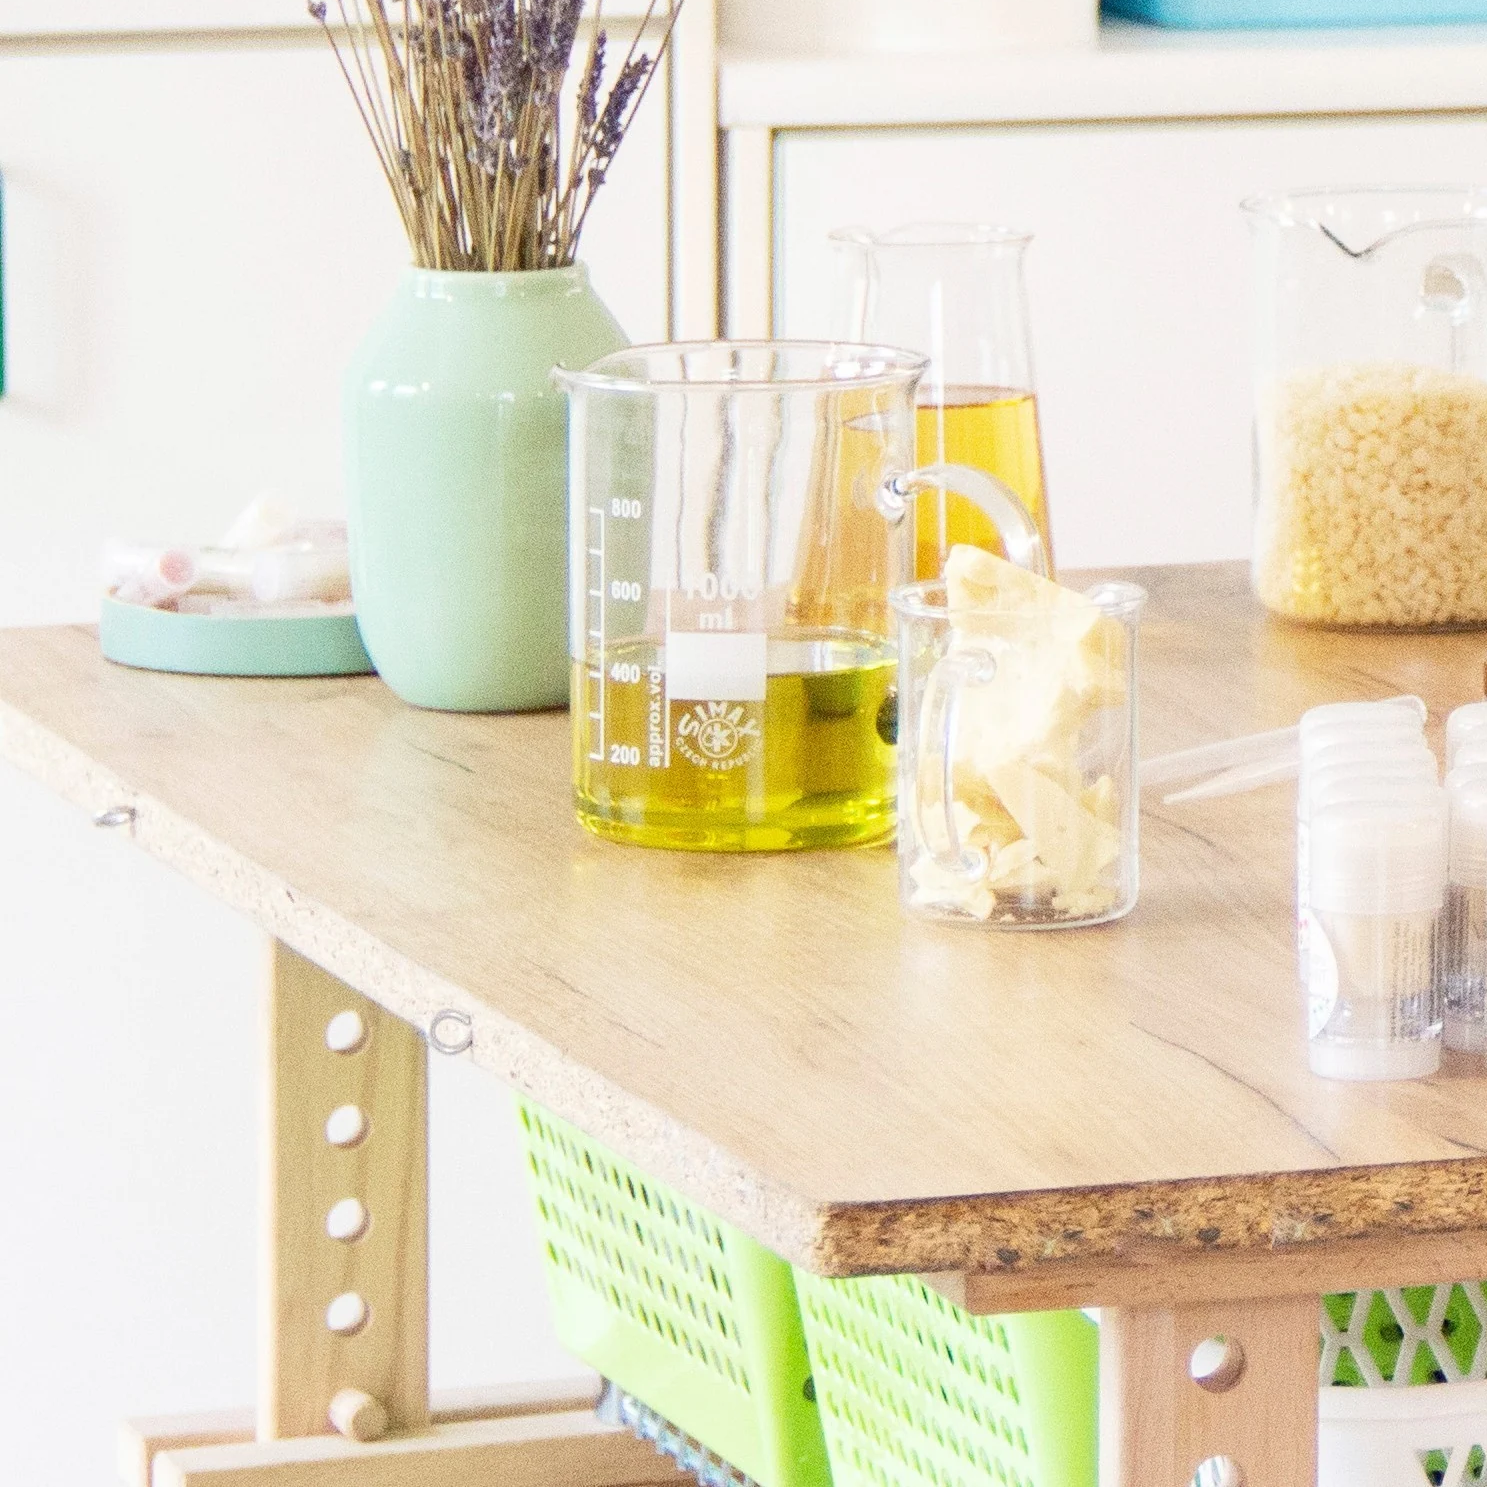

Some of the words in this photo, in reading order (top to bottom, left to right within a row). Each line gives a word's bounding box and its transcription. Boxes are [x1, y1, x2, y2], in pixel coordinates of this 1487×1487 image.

[610, 498, 642, 520] 800
[610, 581, 642, 602] 600
[698, 606, 734, 631] ml
[609, 663, 641, 684] 400
[677, 700, 761, 737] SIMAX
[610, 744, 641, 766] 200
[675, 736, 708, 768] CZECH
